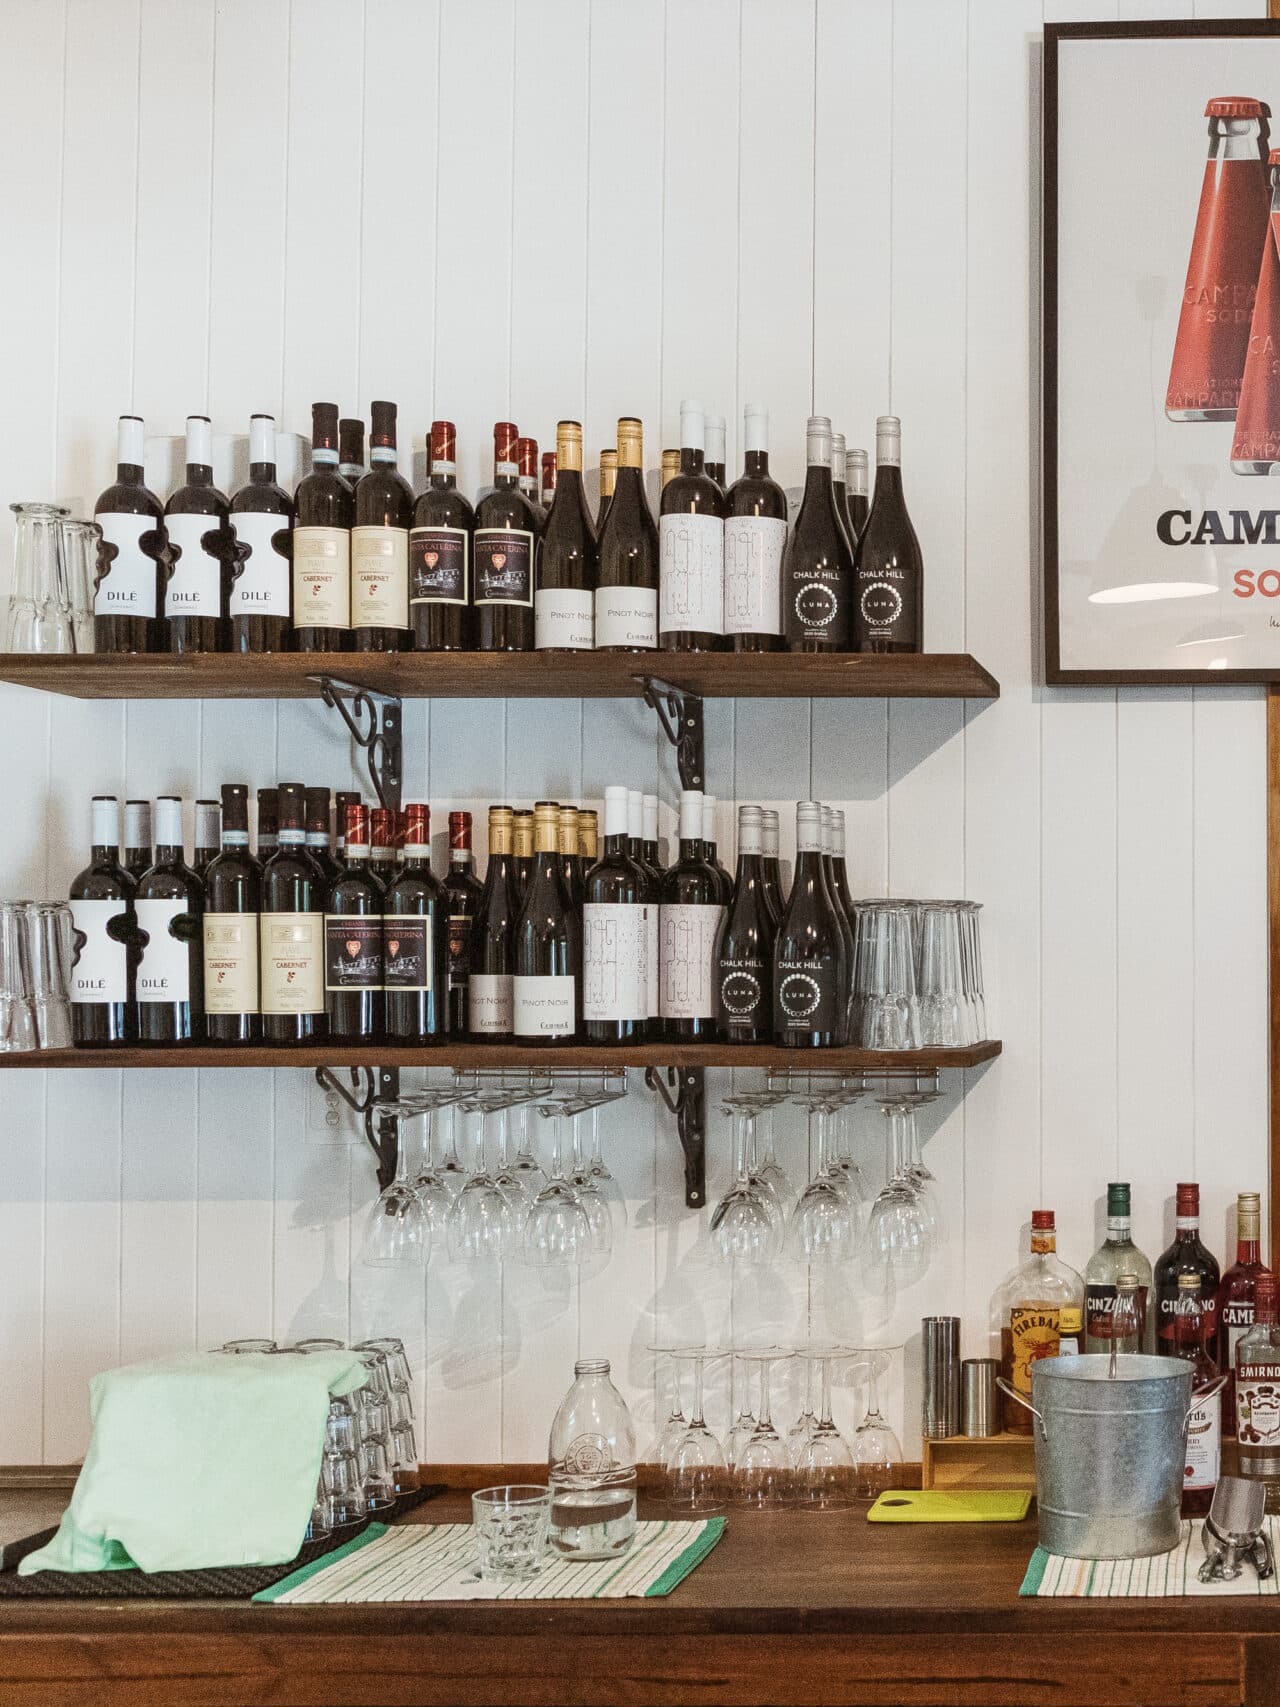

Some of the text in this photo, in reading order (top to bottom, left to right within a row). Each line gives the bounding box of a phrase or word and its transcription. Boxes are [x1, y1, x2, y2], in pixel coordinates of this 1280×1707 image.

[793, 571, 840, 580] CHALK HILL
[860, 570, 904, 579] CHALK HILL
[550, 611, 575, 619] PINOT
[607, 609, 632, 617] PINOT
[720, 960, 763, 968] CHALK HILL
[779, 961, 823, 969] CHALK HILL
